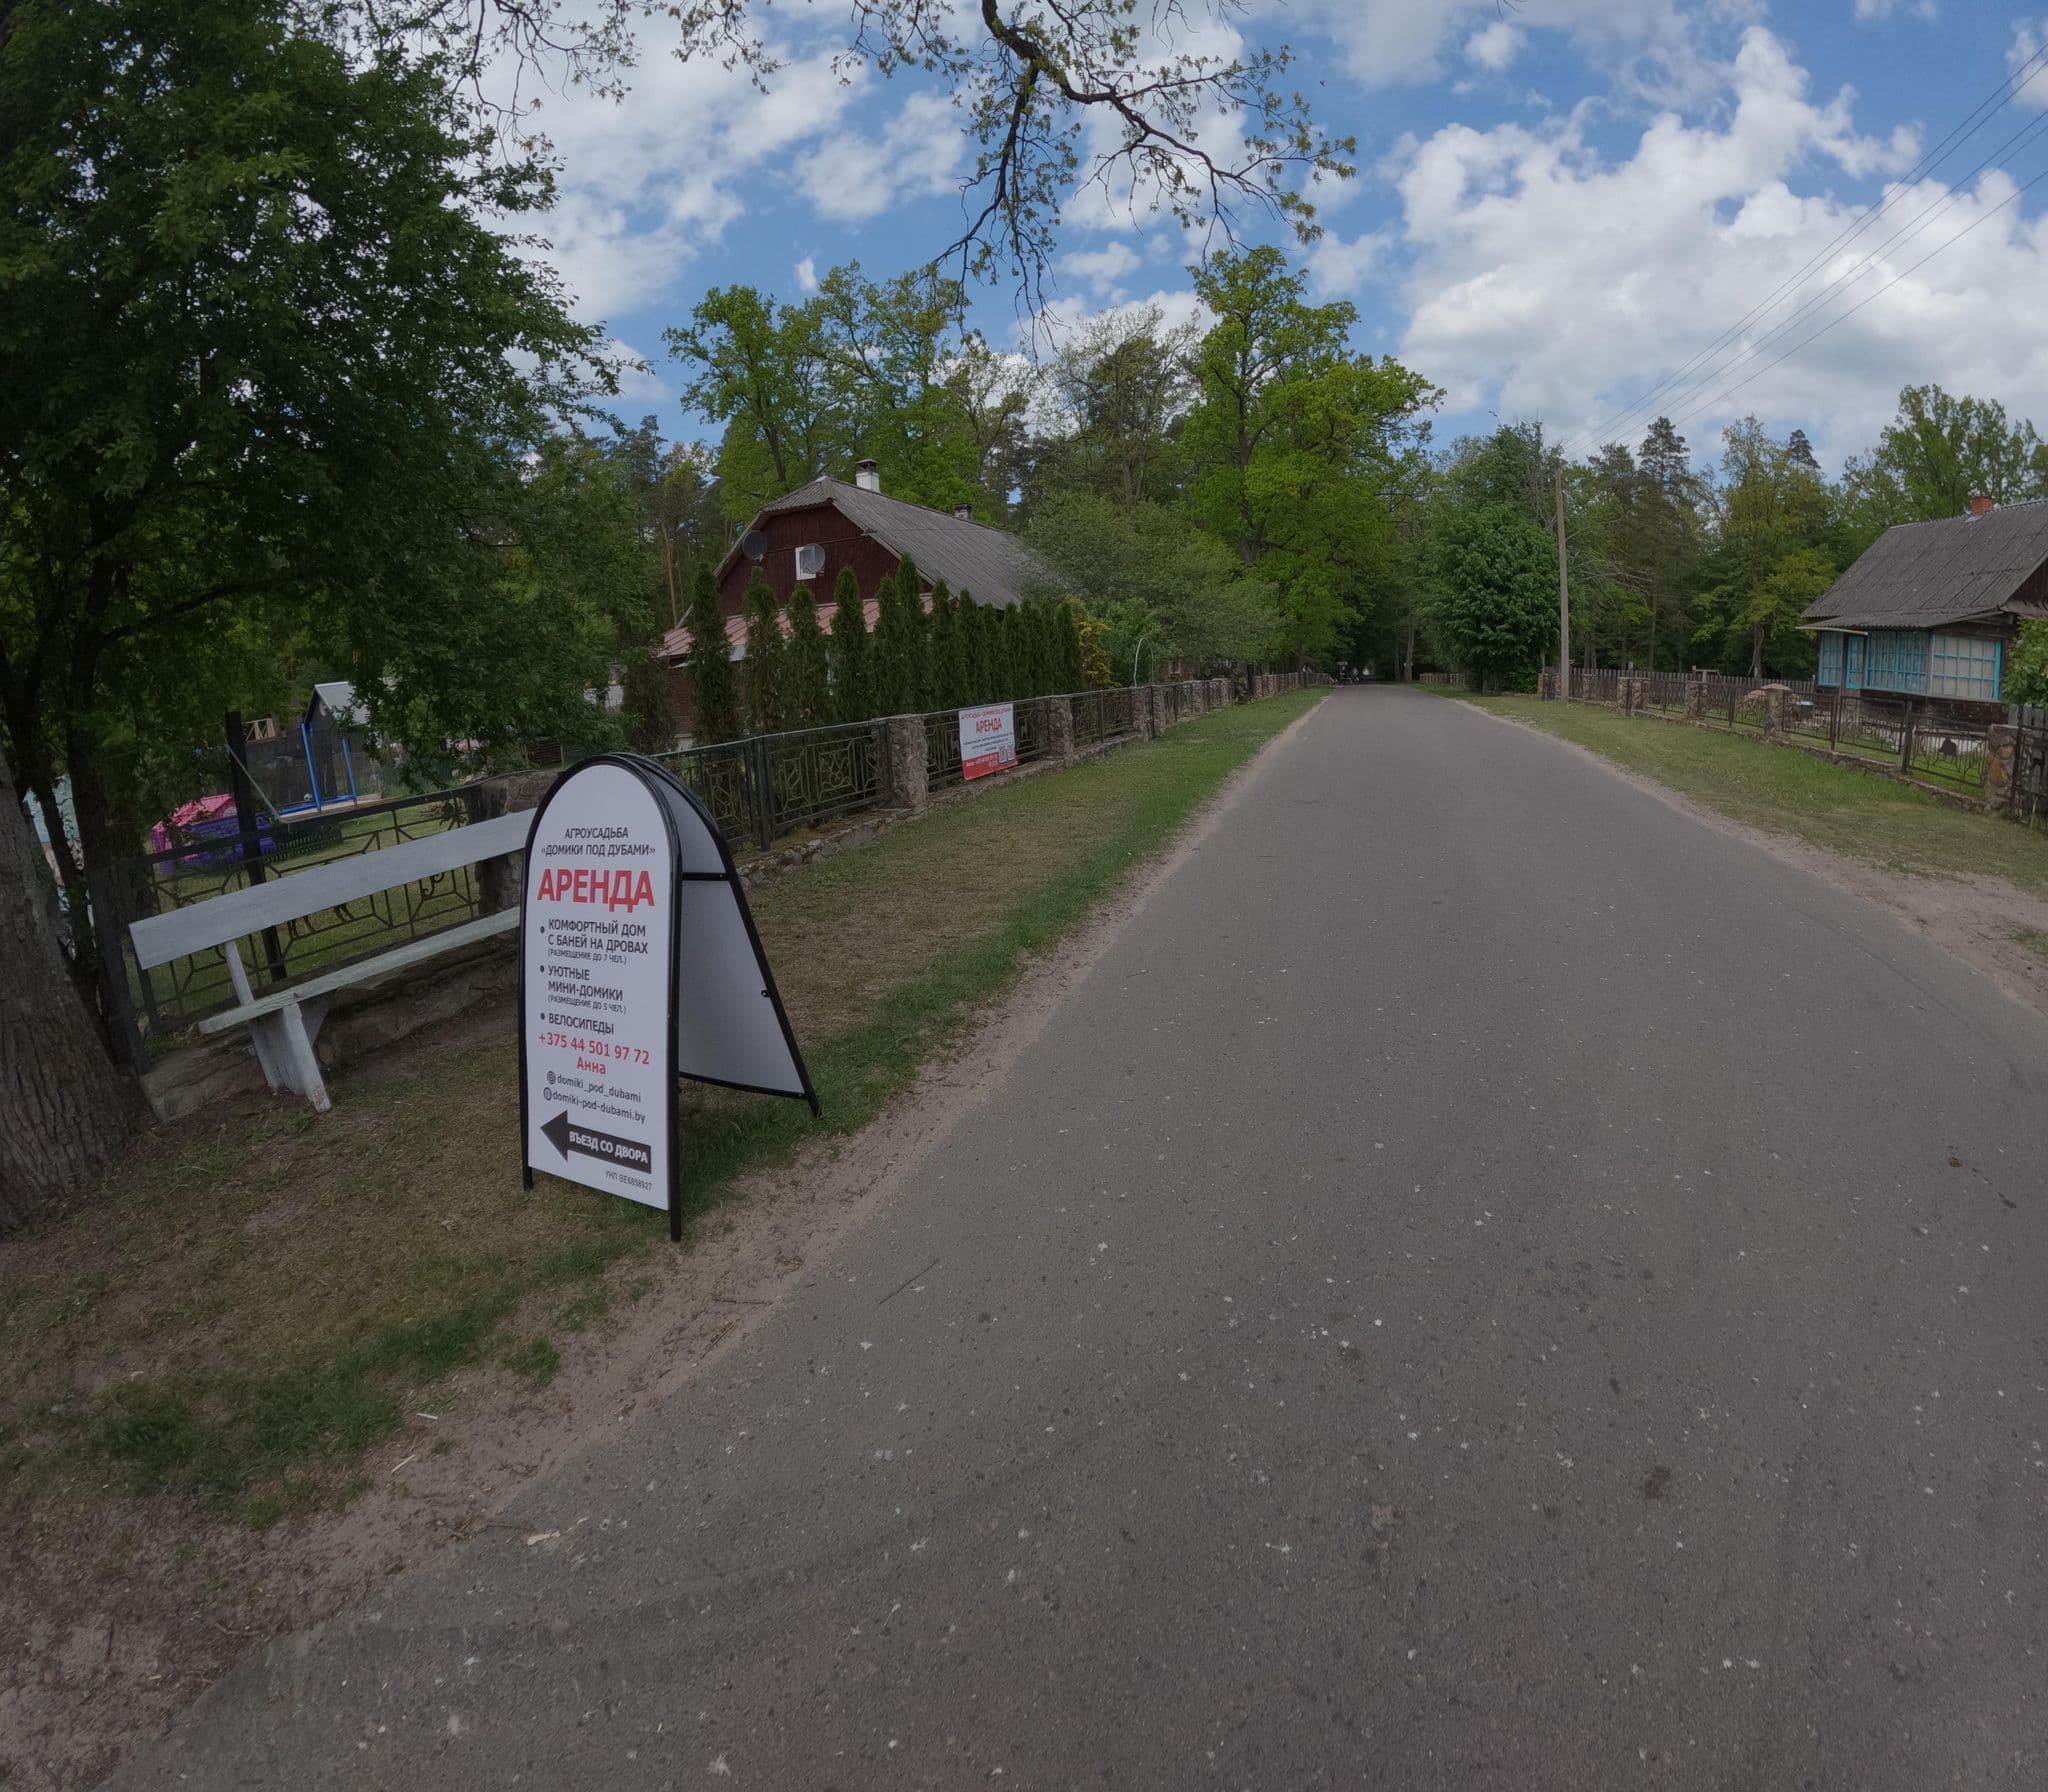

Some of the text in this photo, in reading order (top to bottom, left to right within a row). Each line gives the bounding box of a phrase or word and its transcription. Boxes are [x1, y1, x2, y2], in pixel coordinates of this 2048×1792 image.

[976, 718, 1002, 734] АРЕНДА
[565, 827, 628, 839] АГРОУСАДЬБА
[541, 844, 655, 857] «ДОМИКИ ПОД ДУБАМИ»
[537, 868, 655, 913] АРЕНДА
[548, 919, 646, 938] КОМФОРТНЫЙ ДОМ
[548, 934, 648, 954] С БАНЕЙ НА ДРОВАХ
[548, 965, 590, 980] УЮТНЫЕ
[548, 981, 623, 1001] МИНИ-ДОМИКИ
[604, 1002, 608, 1011] 5
[549, 1013, 614, 1035] ВЕЛОСИПЕДЫ
[538, 1032, 650, 1064] +375 44 501 97 72
[577, 1057, 606, 1074] Анна
[553, 1090, 646, 1124] domiki-pod-dubami.by
[569, 1131, 648, 1163] ВЪЕЗД СО ДВОРА
